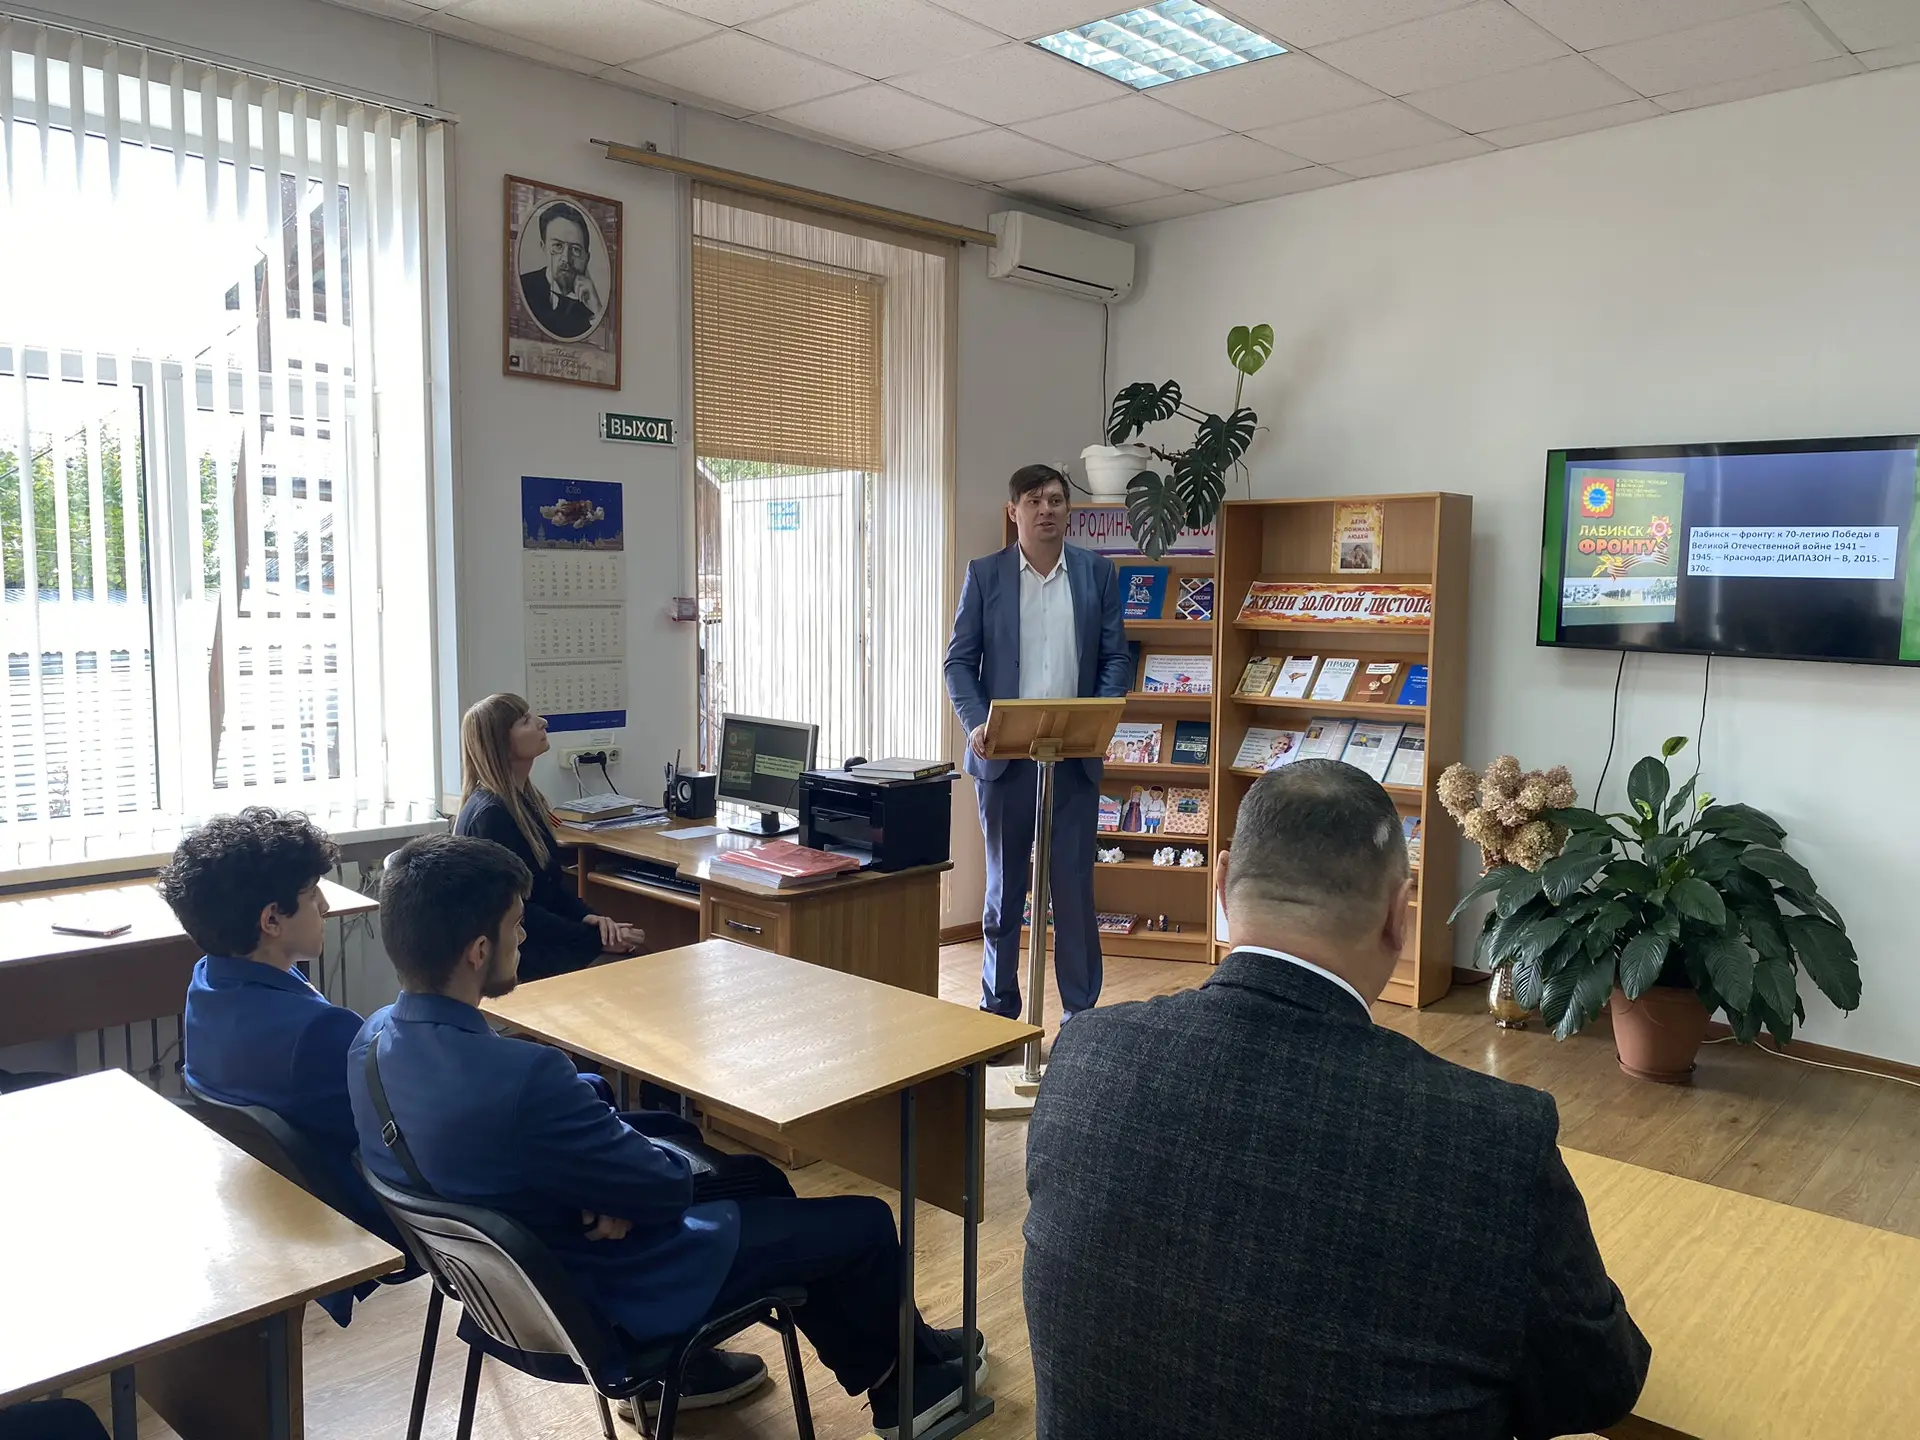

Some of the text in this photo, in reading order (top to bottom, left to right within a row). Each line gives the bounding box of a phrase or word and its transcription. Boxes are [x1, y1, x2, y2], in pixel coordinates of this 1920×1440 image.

[611, 418, 668, 441] ВЫХОД
[1579, 524, 1644, 536] ЛАБИНСК
[1692, 530, 1730, 538] Лабинск
[1739, 530, 1775, 539] фронту:
[1785, 530, 1830, 538] 70-летию
[1832, 530, 1871, 539] Победы
[1578, 537, 1657, 555] ФРОНТУ
[1731, 542, 1800, 550] Отечественной
[1802, 542, 1832, 550] войне
[1834, 542, 1857, 550] 1941
[1691, 553, 1714, 561] 1945.
[1723, 553, 1775, 562] Краснодар:
[1777, 554, 1831, 563] ДИАПАЗОН
[1853, 554, 1880, 563] 2015.
[1691, 564, 1712, 572] 370с.
[1131, 576, 1143, 584] 20
[1325, 660, 1355, 668] ПРАВО
